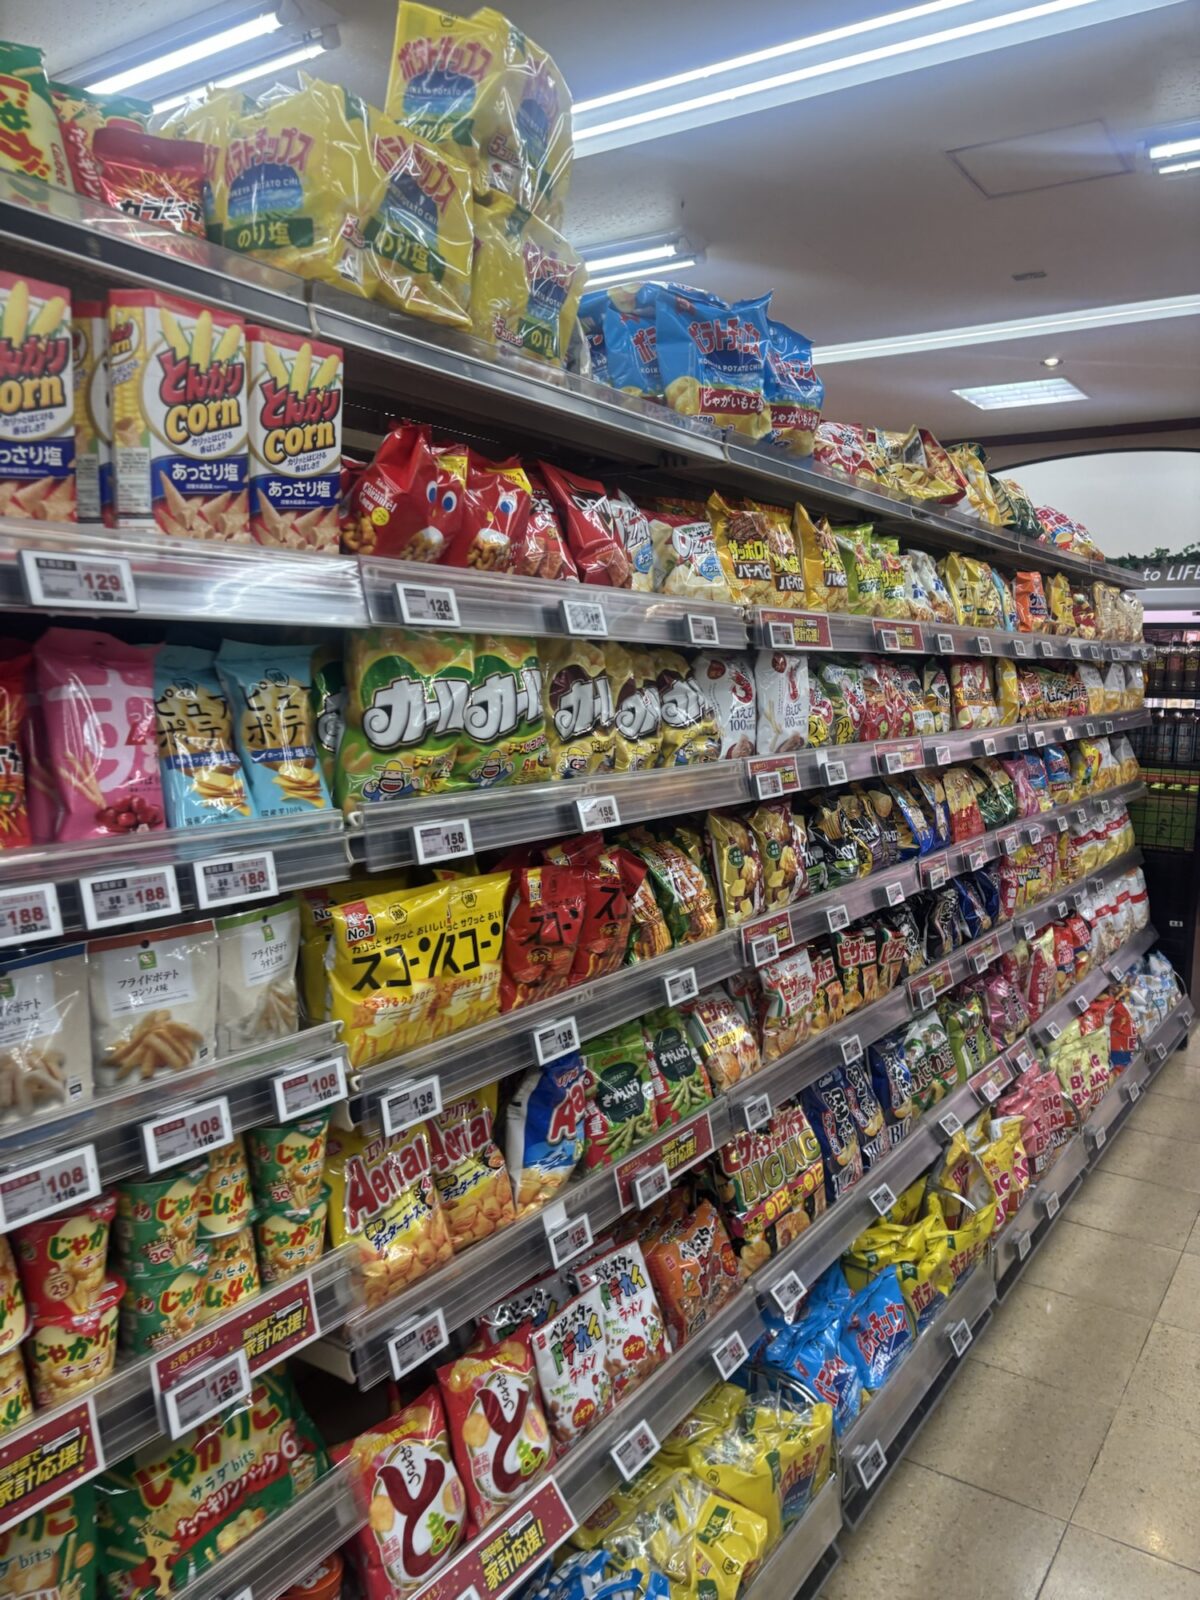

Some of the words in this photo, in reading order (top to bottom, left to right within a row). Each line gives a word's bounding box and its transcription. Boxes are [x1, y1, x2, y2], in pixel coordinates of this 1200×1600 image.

[238, 221, 290, 248] のり塩
[158, 350, 244, 404] とんがり
[259, 380, 340, 430] とんがり
[171, 463, 239, 482] あっさり塩
[268, 481, 331, 499] あっさり塩
[84, 572, 121, 591] 129
[1143, 568, 1161, 581] to
[429, 598, 451, 613] 128
[599, 805, 614, 818] 158
[444, 832, 465, 846] 158
[240, 871, 266, 886] 188
[135, 886, 165, 904] 188
[7, 906, 44, 926] 188
[347, 916, 376, 941] No.1
[352, 940, 382, 955] カリッと
[385, 931, 414, 946] サクッと
[417, 921, 447, 937] おいしい
[352, 933, 447, 991] スコーン
[117, 969, 180, 989] フライドポテト
[131, 984, 169, 998] コンソメ味
[557, 1030, 573, 1044] 138
[312, 1073, 337, 1094] 108
[412, 1093, 434, 1110] 138
[190, 1116, 220, 1139] 108
[47, 1167, 84, 1193] 108
[345, 1133, 432, 1231] Aerial
[55, 1187, 77, 1203] 116
[571, 1226, 586, 1244] 129
[551, 1303, 593, 1339] ベビースター
[619, 1299, 643, 1322] ラーメン
[419, 1325, 440, 1347] 129
[569, 1352, 596, 1384] ラーメン
[210, 1369, 239, 1396] 129
[495, 1373, 516, 1412] おさつ
[637, 1433, 651, 1451] 99
[232, 1449, 256, 1473] bits
[400, 1444, 422, 1486] おさつ
[177, 1452, 279, 1537] たべキリンパック
[280, 1431, 298, 1459] 6
[484, 1518, 547, 1592] 家計応援!
